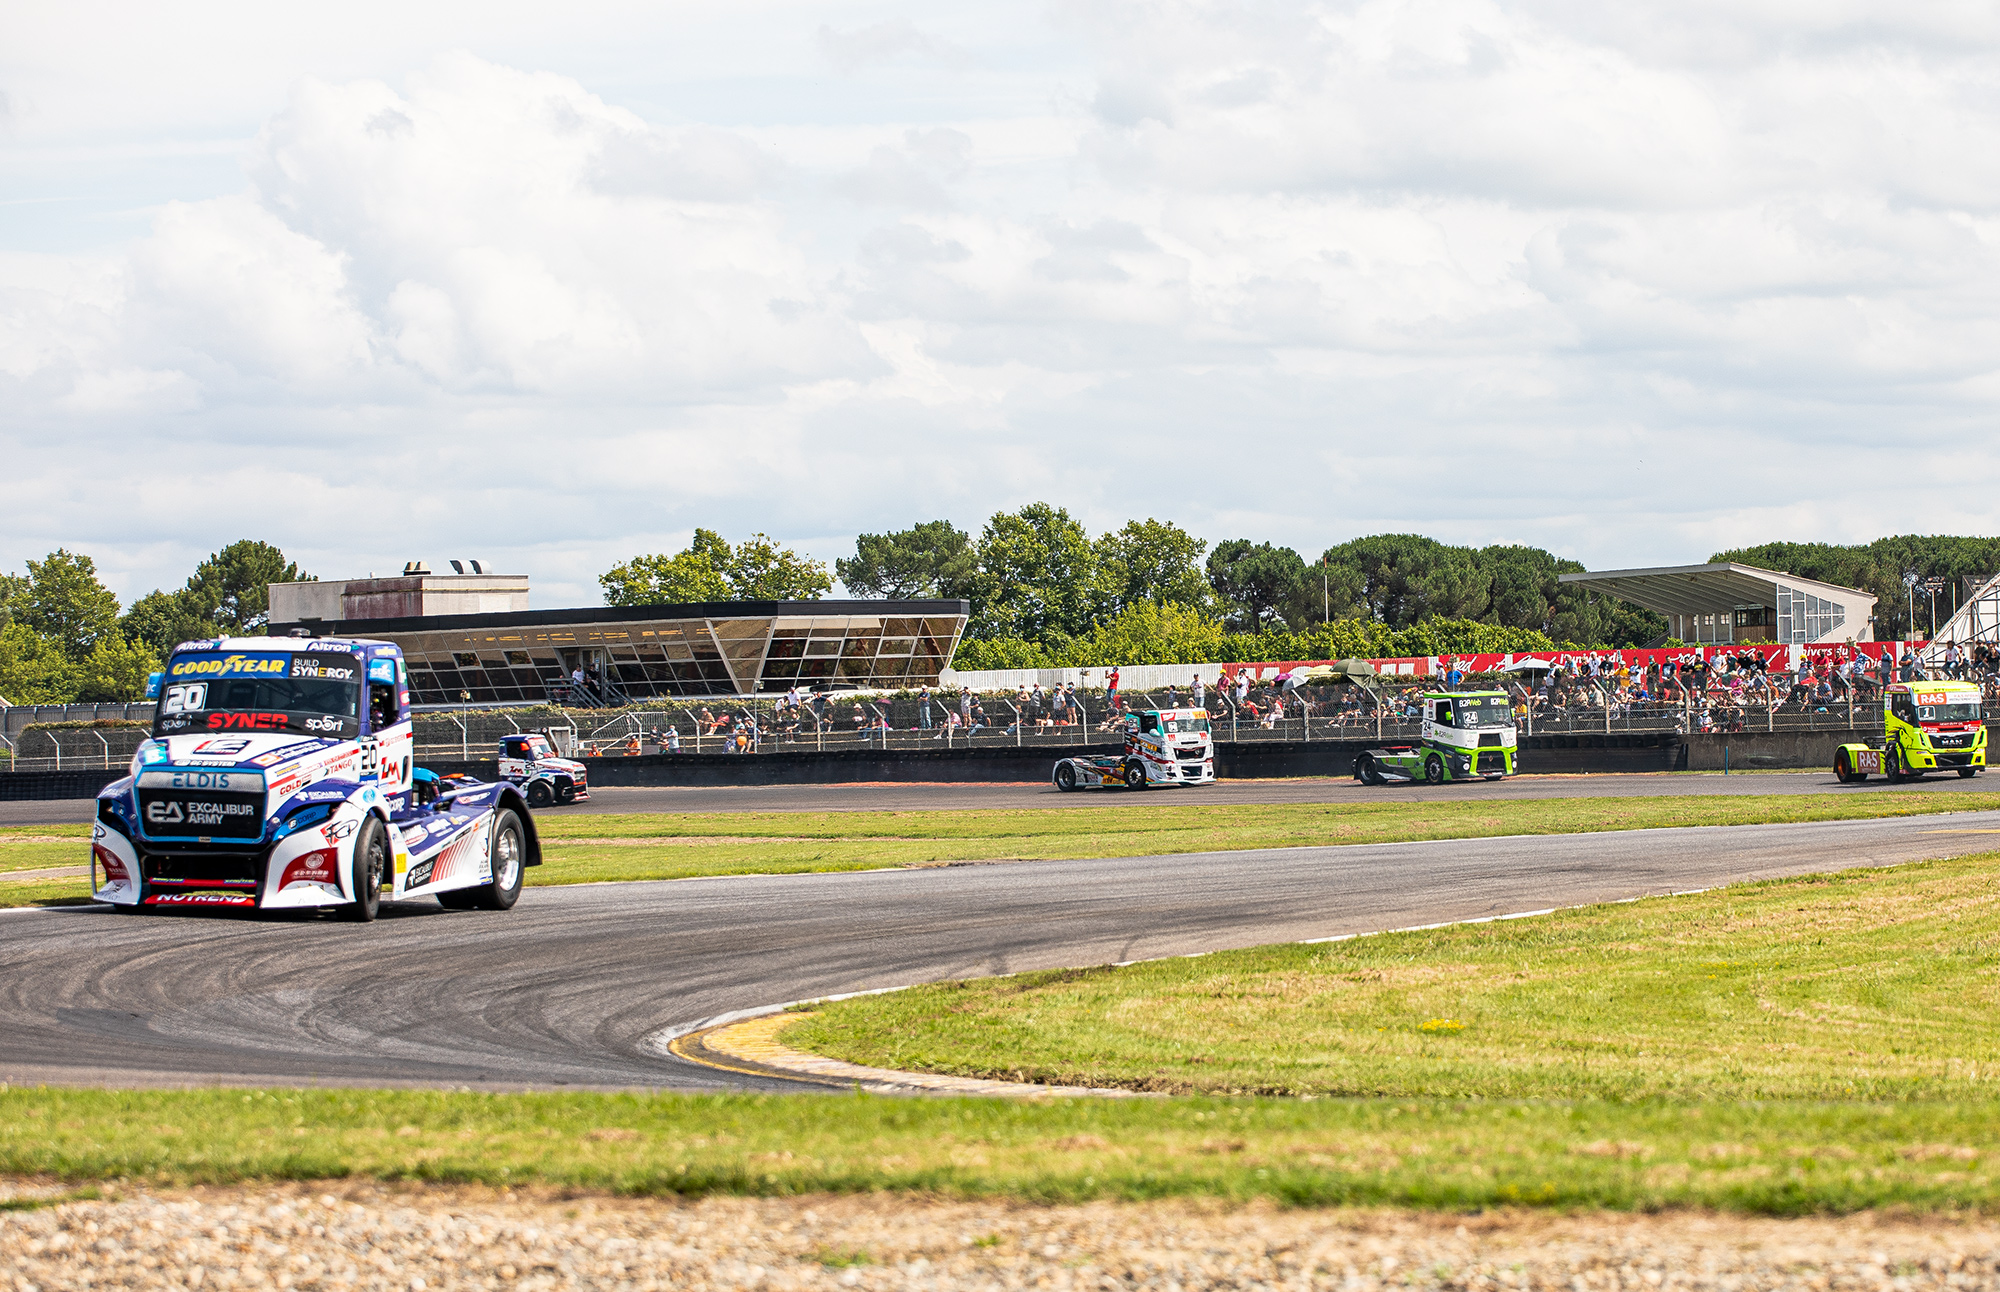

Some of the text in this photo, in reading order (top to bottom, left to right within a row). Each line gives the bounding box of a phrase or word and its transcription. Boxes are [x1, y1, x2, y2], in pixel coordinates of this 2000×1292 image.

[178, 641, 215, 652] Altron
[307, 642, 352, 653] Altron
[172, 655, 286, 677] GOODYEAR
[293, 658, 320, 667] BUILD
[291, 666, 354, 679] SYNERGY
[165, 685, 206, 711] 20
[1459, 698, 1482, 708] B2PWeb
[1465, 712, 1477, 721] 24
[1923, 707, 1931, 718] 1
[1423, 721, 1432, 731] 24
[1941, 738, 1963, 746] MAN
[361, 744, 378, 770] 20
[202, 760, 237, 768] SYSTEM
[330, 758, 353, 774] TANGO
[172, 773, 230, 788] ELDIS
[280, 780, 302, 795] GOLD
[187, 802, 254, 816] EXCALIBUR
[187, 814, 224, 825] ARMY
